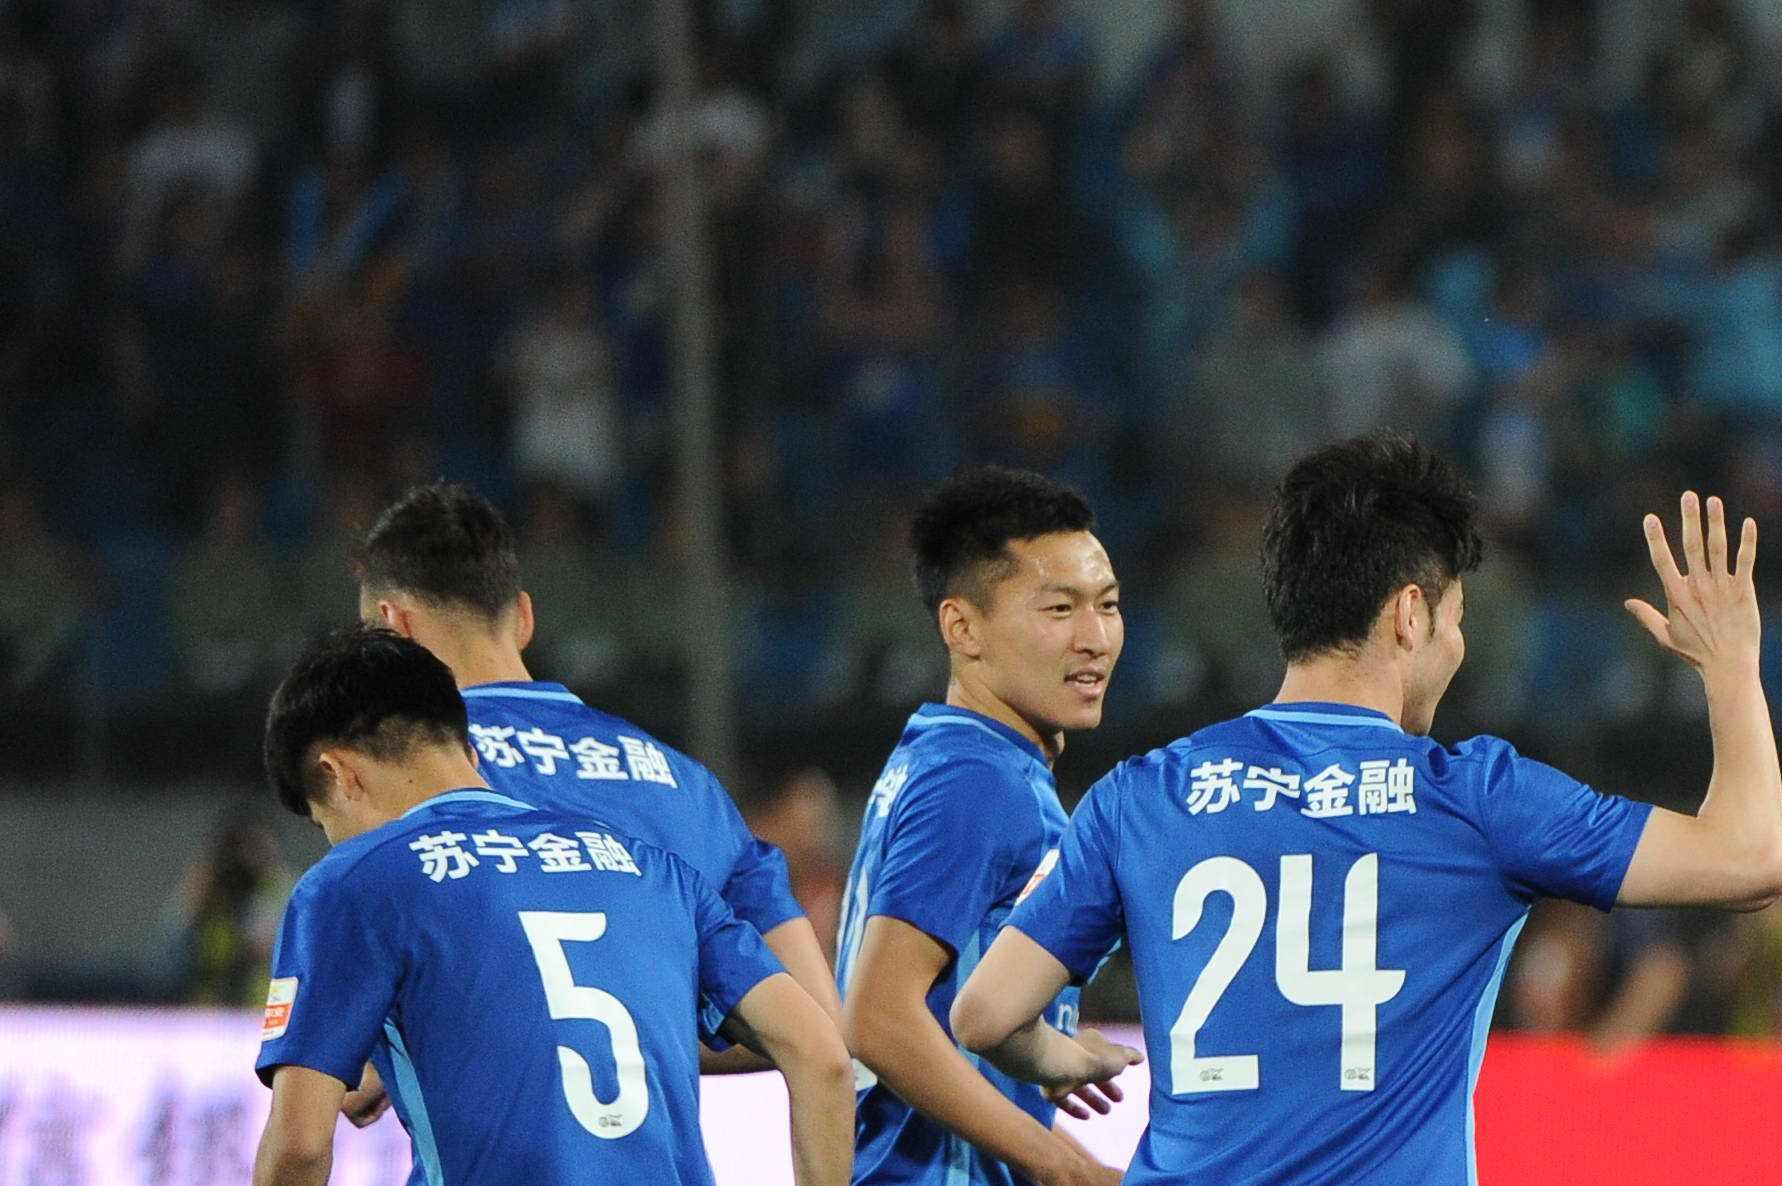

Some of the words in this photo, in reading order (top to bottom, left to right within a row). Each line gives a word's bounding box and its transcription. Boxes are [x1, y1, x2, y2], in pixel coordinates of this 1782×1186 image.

[468, 724, 678, 789] 苏宁金融
[1187, 758, 1416, 818] 苏宁金融
[410, 829, 642, 884] 苏宁金融
[1170, 853, 1406, 1095] 24
[519, 911, 649, 1140] 5
